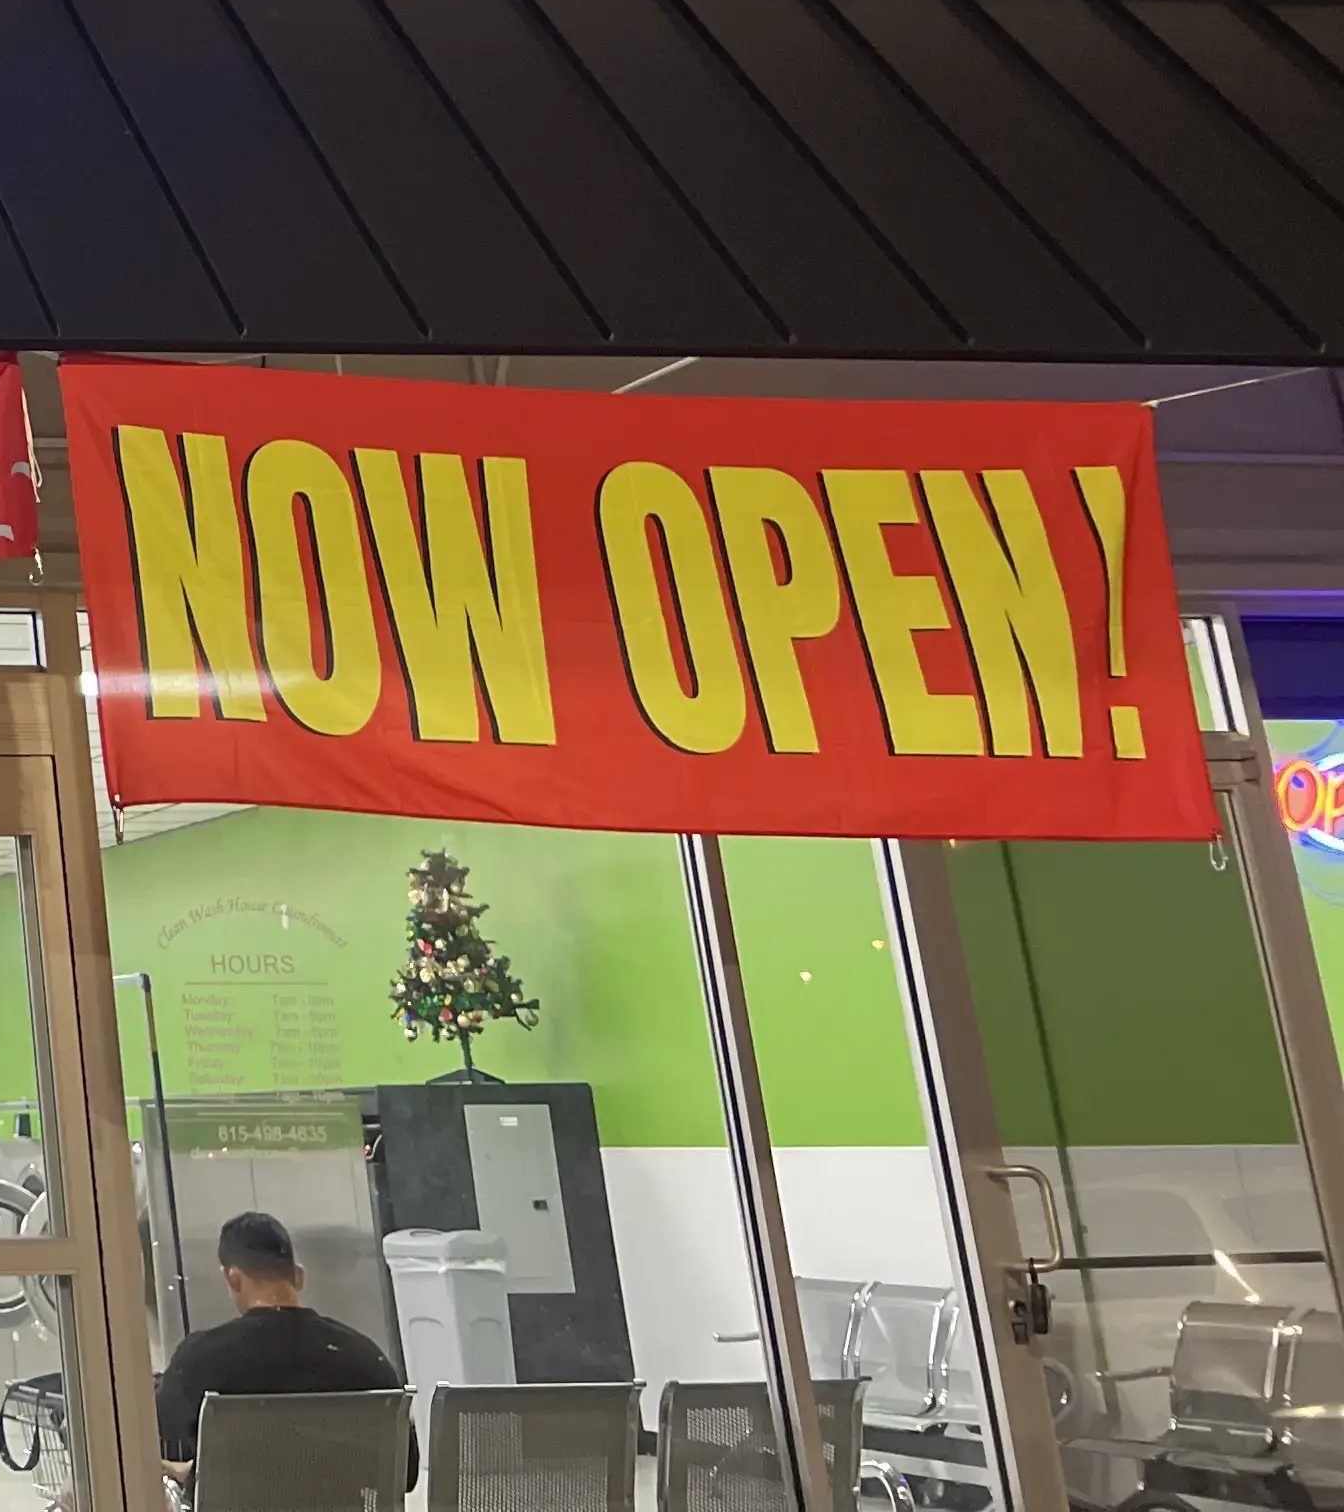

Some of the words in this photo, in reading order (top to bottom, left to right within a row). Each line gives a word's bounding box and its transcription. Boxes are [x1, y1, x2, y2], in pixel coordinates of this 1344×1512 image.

[113, 424, 556, 746] NOW
[594, 461, 1146, 759] OPEN!
[211, 954, 295, 975] HOURS
